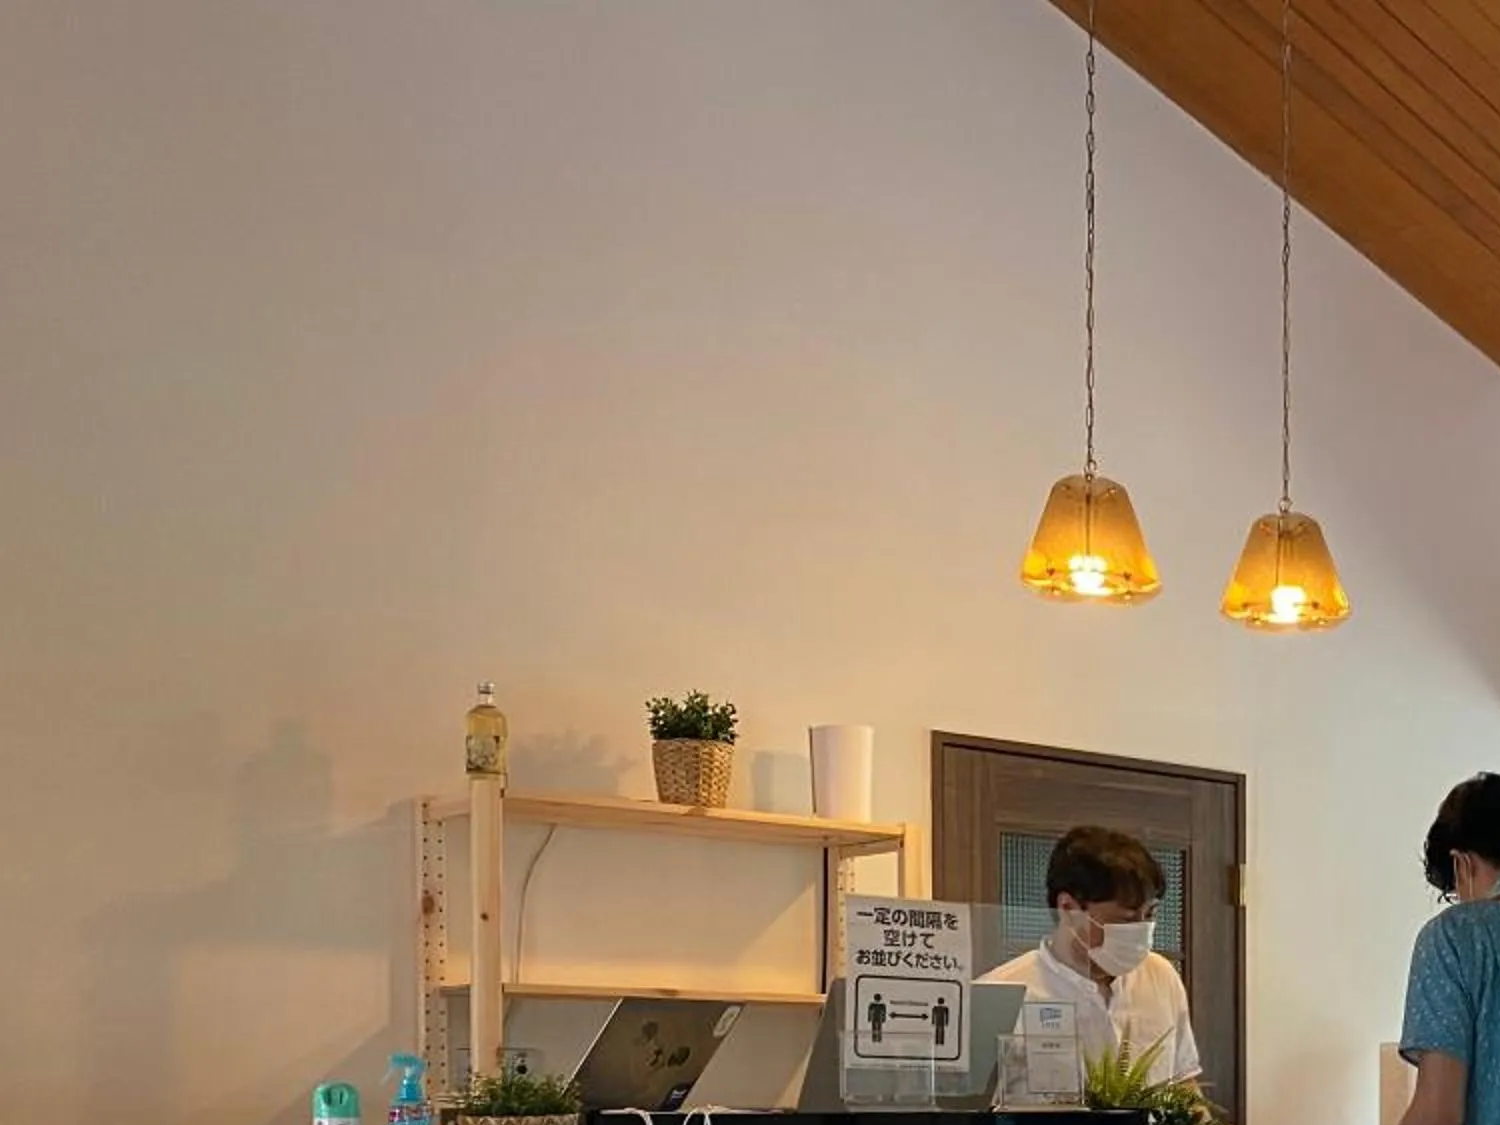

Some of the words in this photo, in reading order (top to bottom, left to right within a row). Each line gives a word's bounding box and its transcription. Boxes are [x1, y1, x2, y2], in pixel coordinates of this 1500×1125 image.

[856, 907, 959, 931] 一定の間隔を
[883, 929, 935, 949] 空けて
